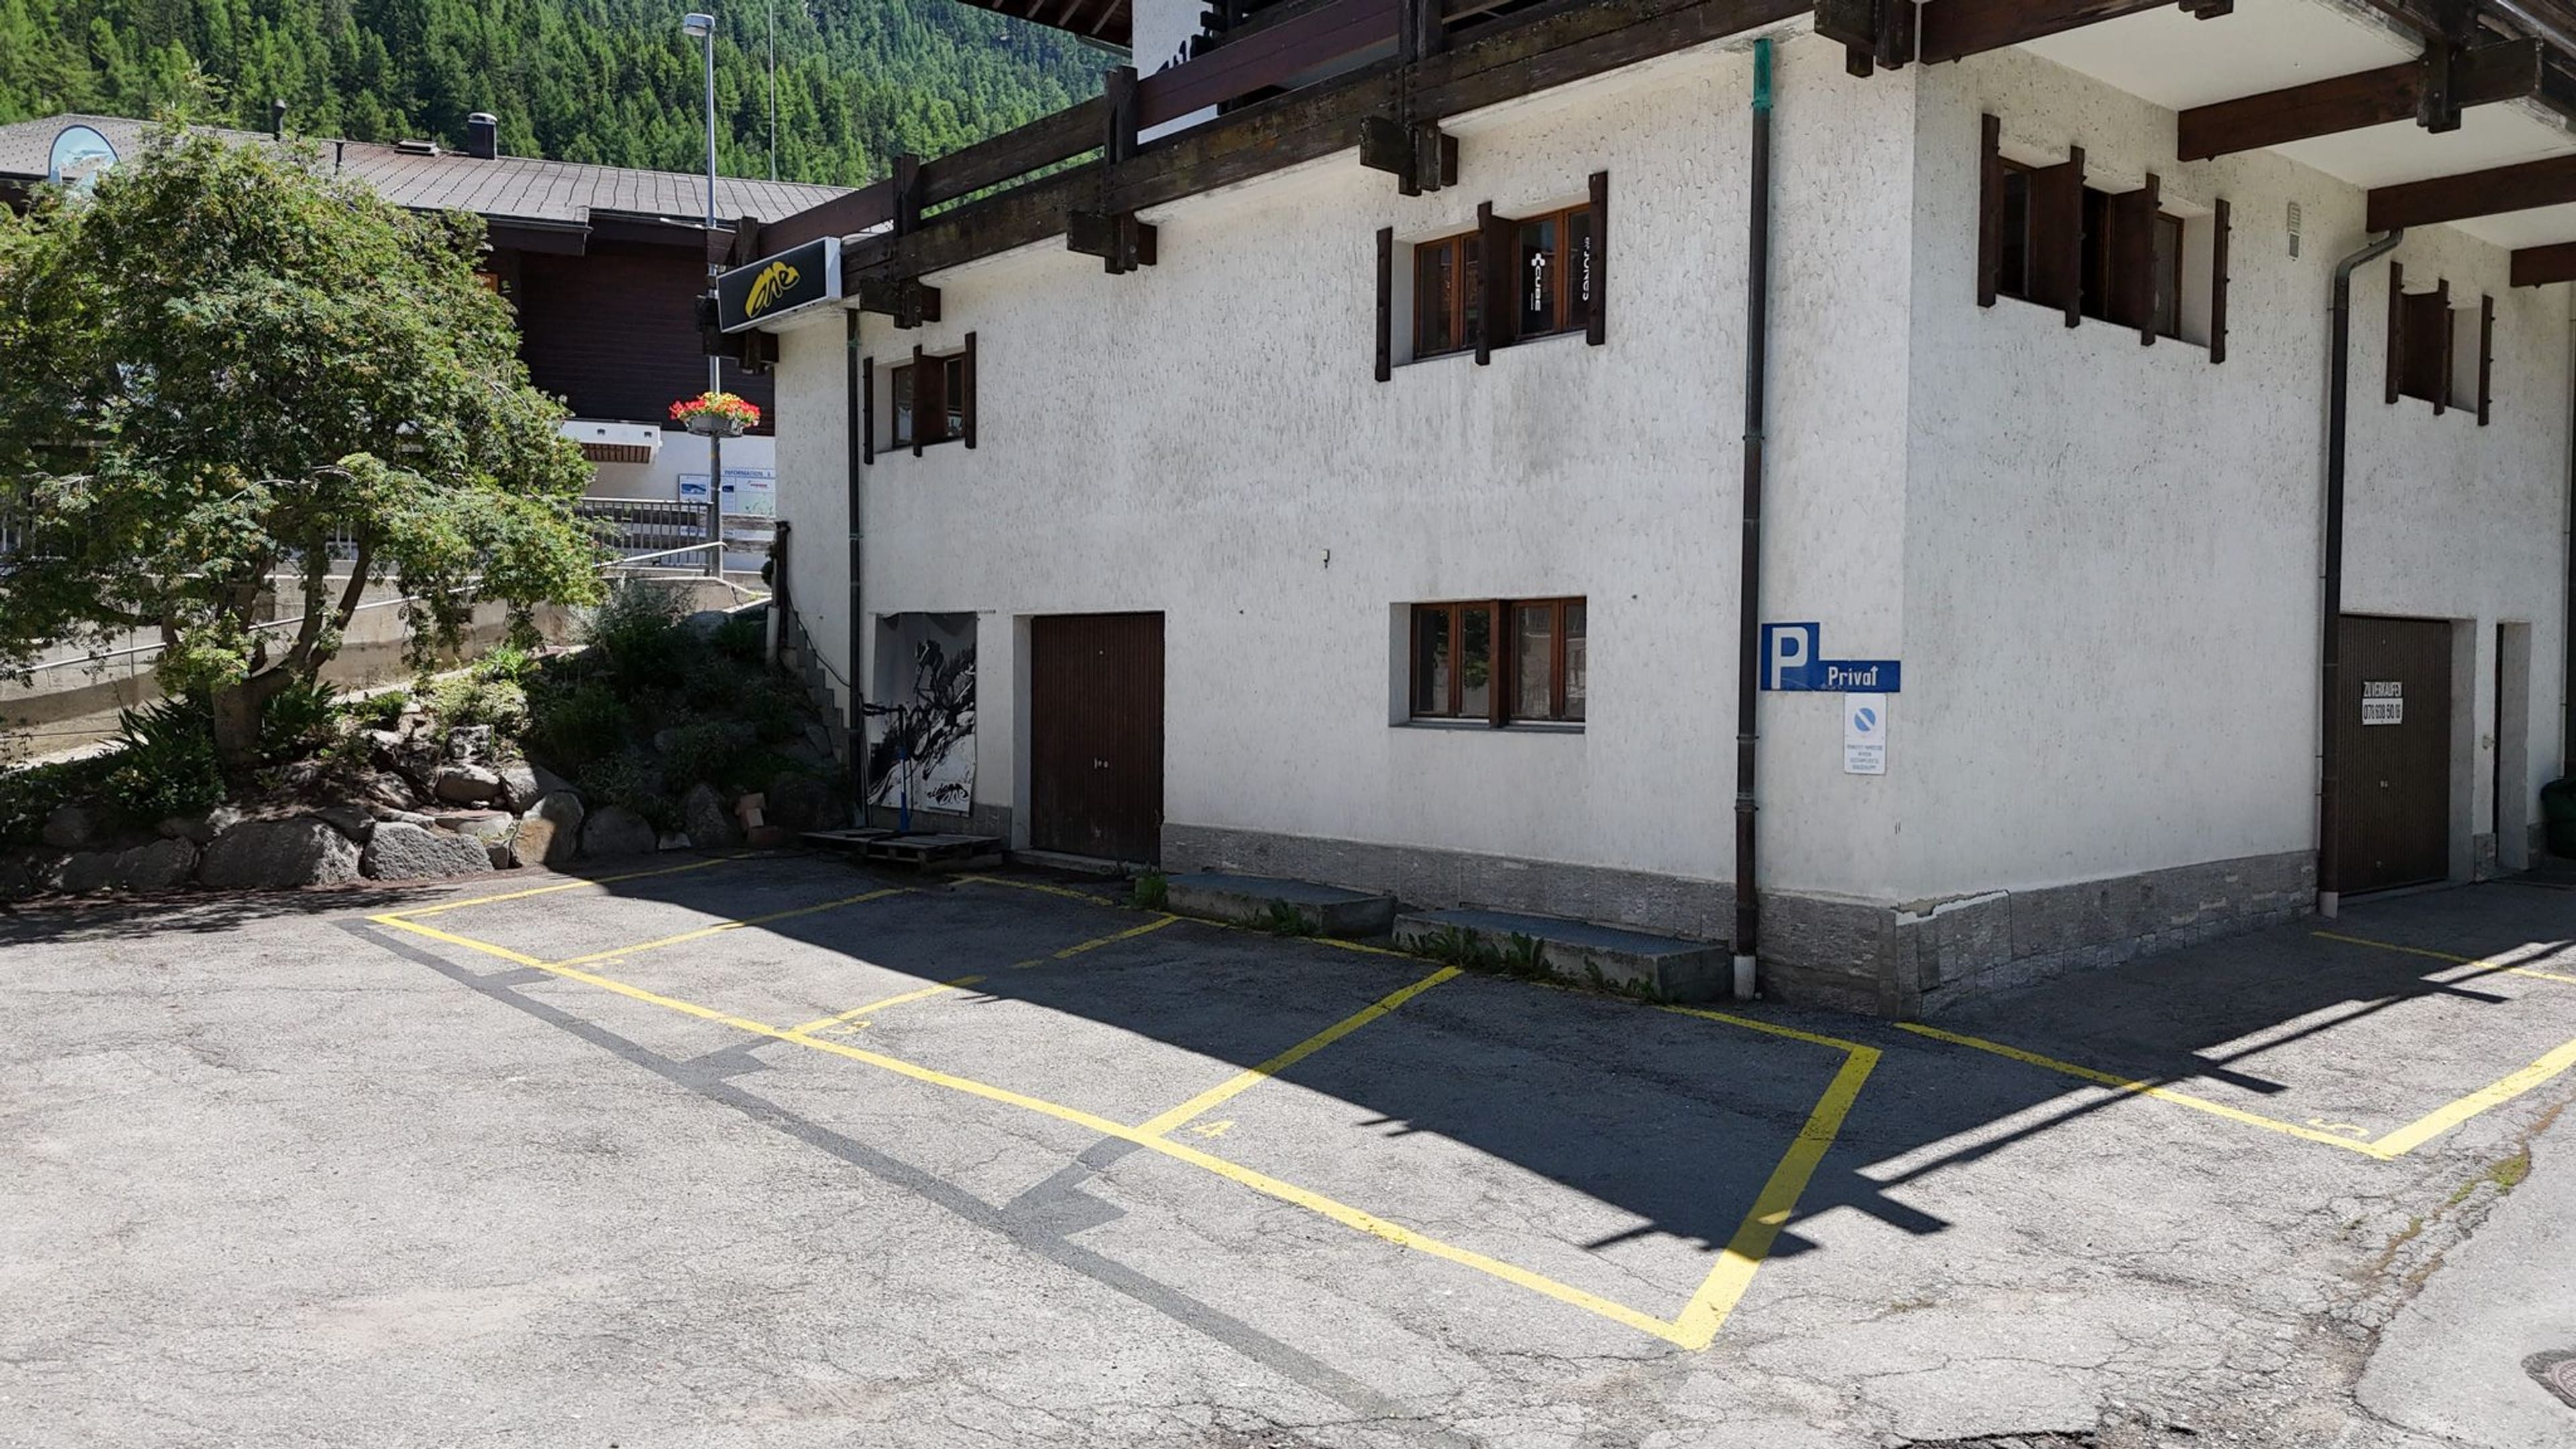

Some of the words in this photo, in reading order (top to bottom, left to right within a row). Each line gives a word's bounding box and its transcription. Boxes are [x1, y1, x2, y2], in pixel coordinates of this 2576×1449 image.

[1771, 627, 1809, 690] P
[1828, 665, 1878, 686] Privat
[2371, 682, 2402, 697] VERKAUFEN
[2386, 704, 2394, 719] 50
[826, 1020, 871, 1034] 3
[1191, 1120, 1234, 1138] 4
